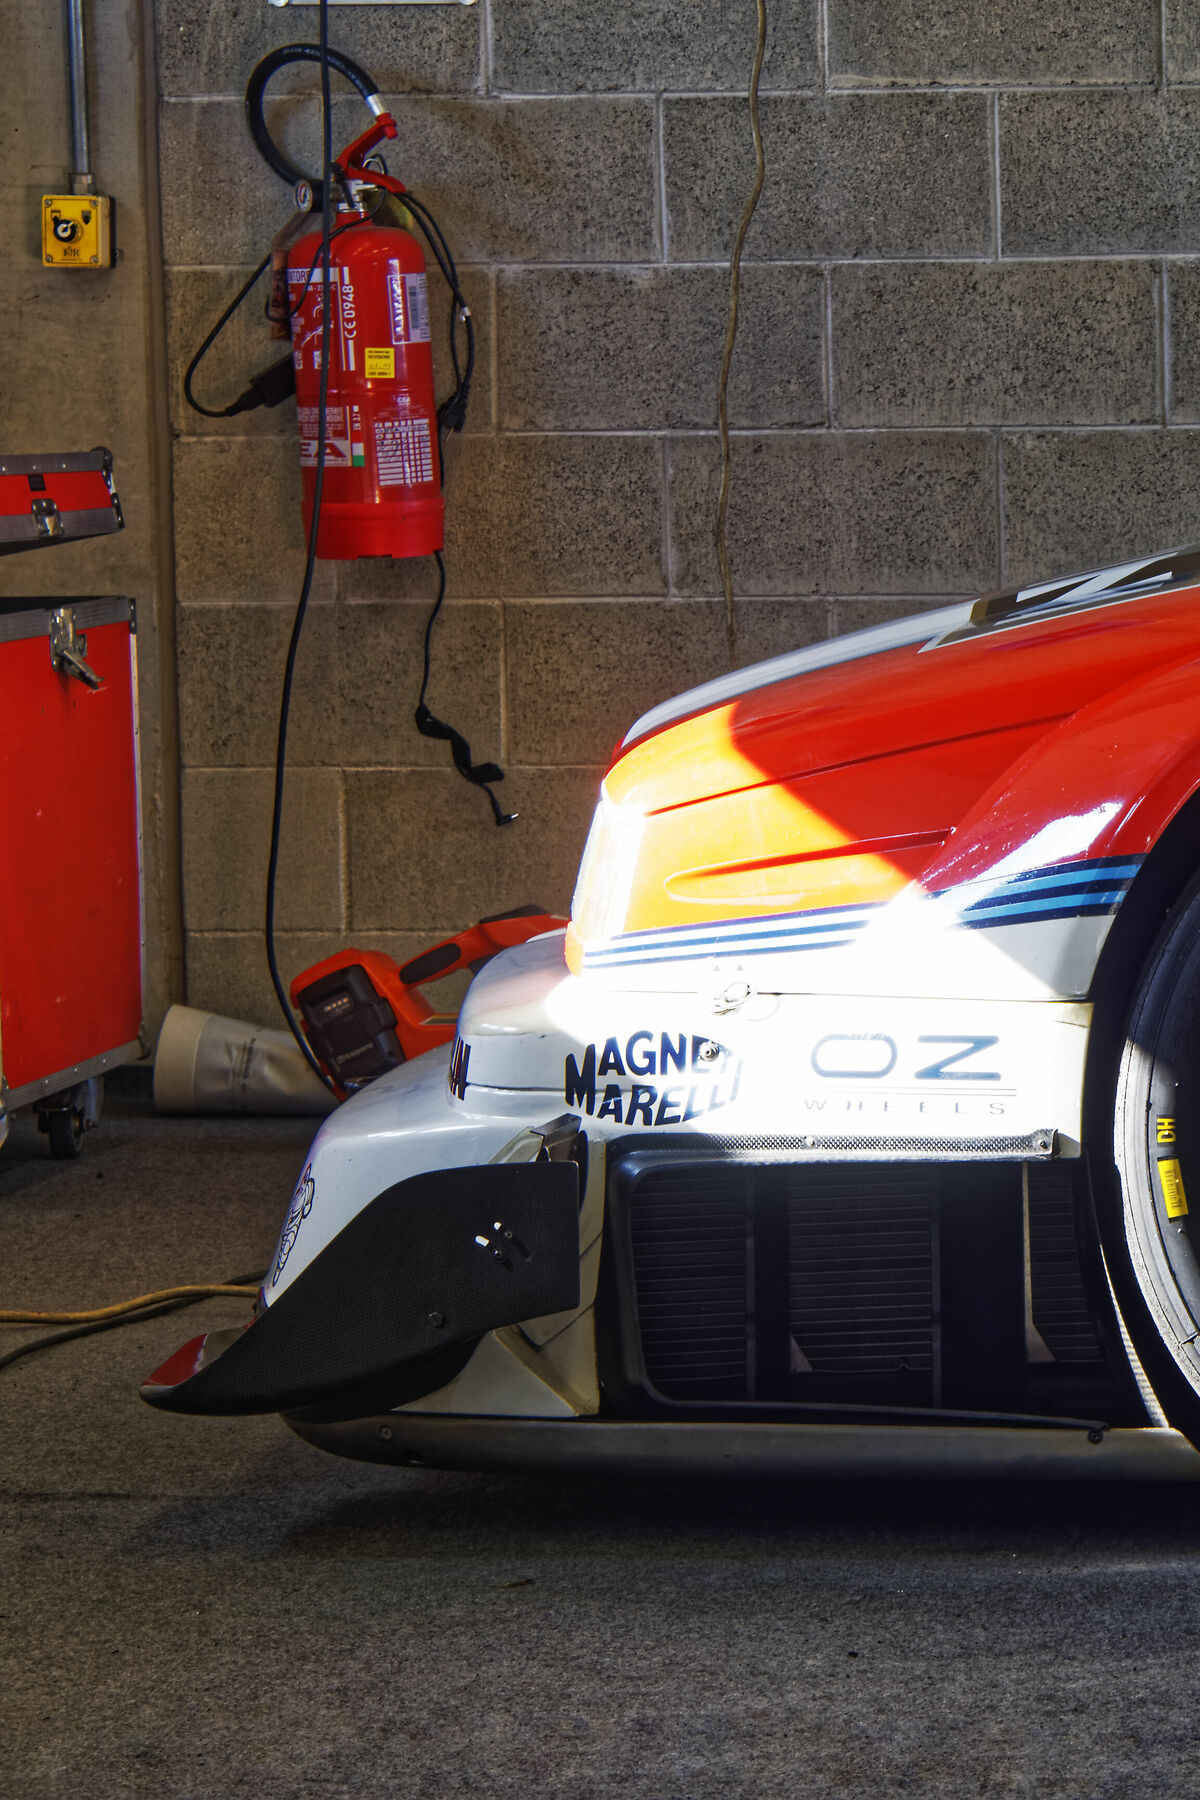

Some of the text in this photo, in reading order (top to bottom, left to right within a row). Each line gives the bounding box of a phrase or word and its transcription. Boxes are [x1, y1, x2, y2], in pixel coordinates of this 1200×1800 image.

[342, 285, 355, 318] 0948
[811, 1033, 1002, 1081] OZ
[566, 1060, 743, 1126] MARELLI
[804, 1099, 1006, 1116] WHEELS
